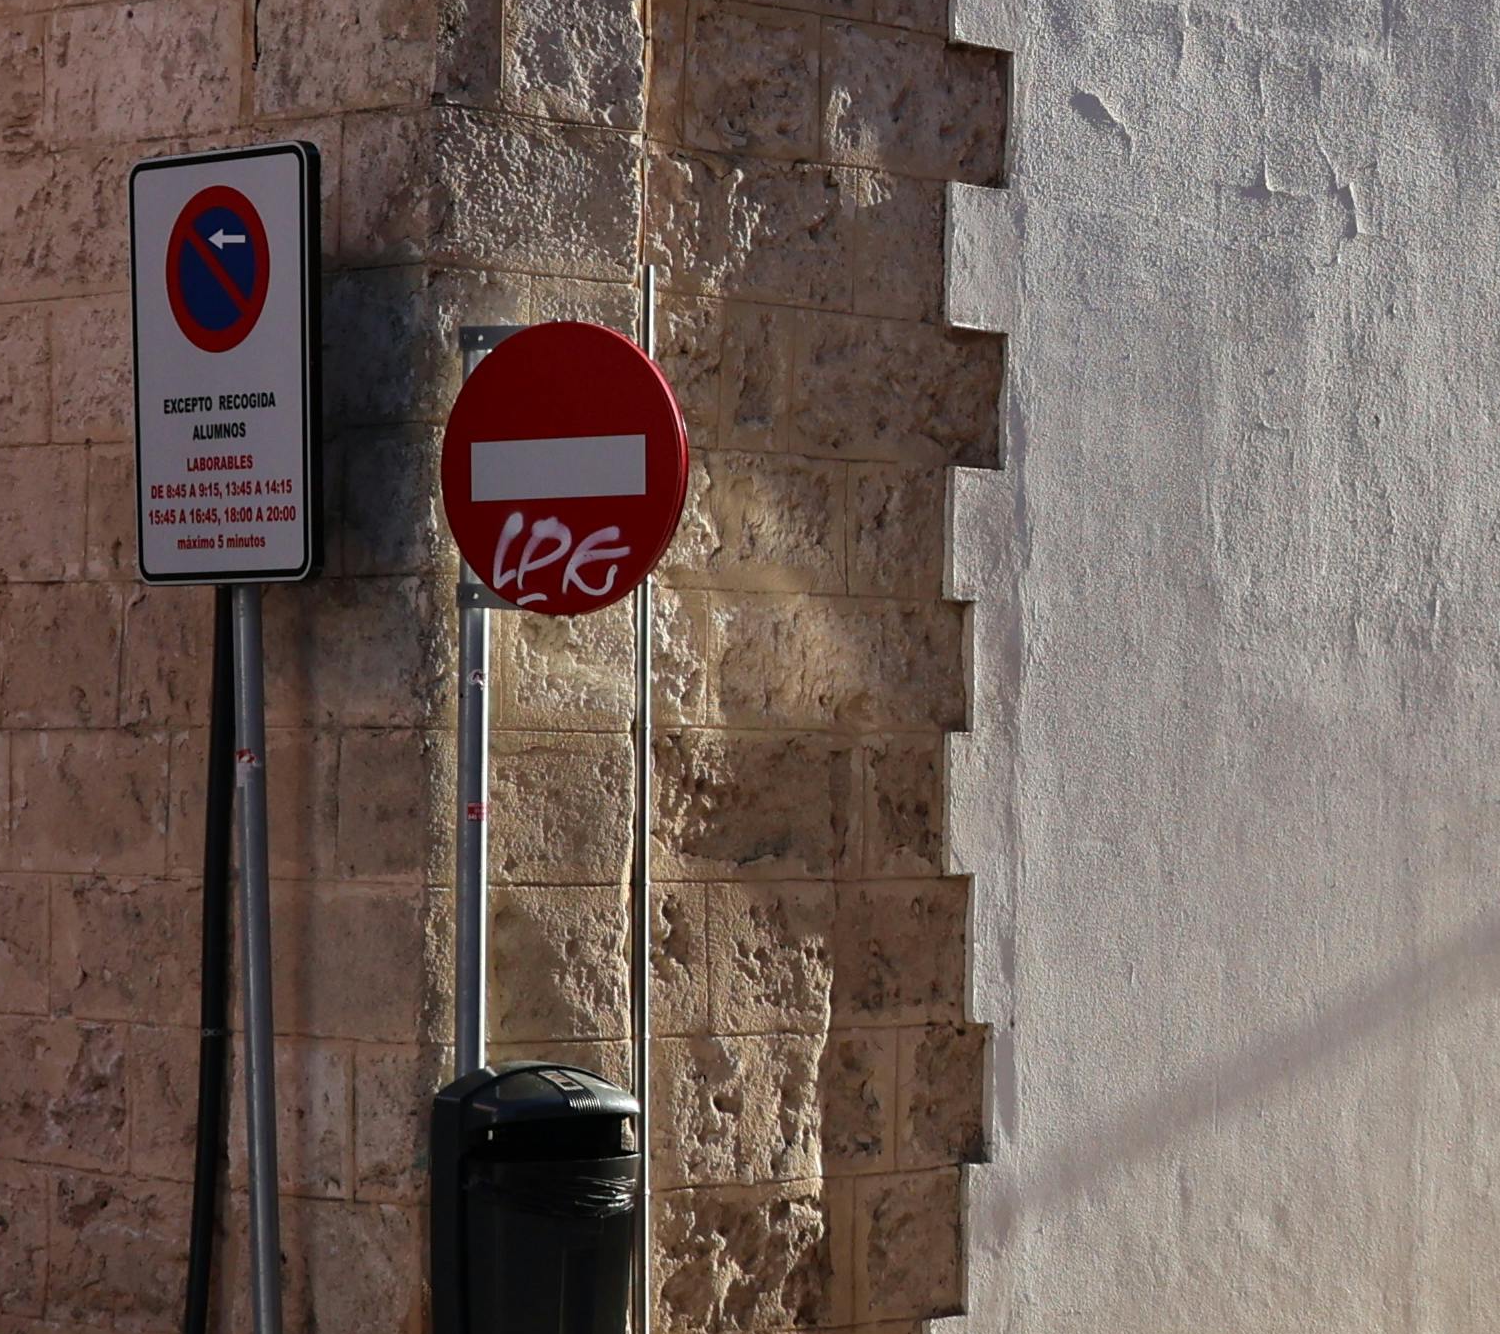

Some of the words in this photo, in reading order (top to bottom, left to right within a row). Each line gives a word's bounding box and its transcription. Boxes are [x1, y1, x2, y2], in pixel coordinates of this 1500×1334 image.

[163, 396, 213, 414] EXCEPTO
[219, 392, 276, 410] RECOGIDA
[192, 422, 246, 440] ALUMNOS
[186, 455, 253, 472] LABORABLES
[151, 484, 164, 499] DE
[166, 483, 187, 498] 8:45
[189, 483, 197, 498] A
[199, 482, 223, 499] 9:15,
[225, 481, 252, 496] 13:45
[254, 481, 262, 495] A
[265, 479, 292, 494] 14:15
[149, 509, 176, 526] 15:45
[179, 509, 187, 525] A
[189, 508, 221, 525] 16:45,
[224, 507, 252, 523] 18:00
[256, 507, 264, 522] A
[267, 506, 296, 521] 20:00
[177, 535, 215, 550] máximo
[218, 535, 224, 548] 5
[226, 534, 266, 548] minutos
